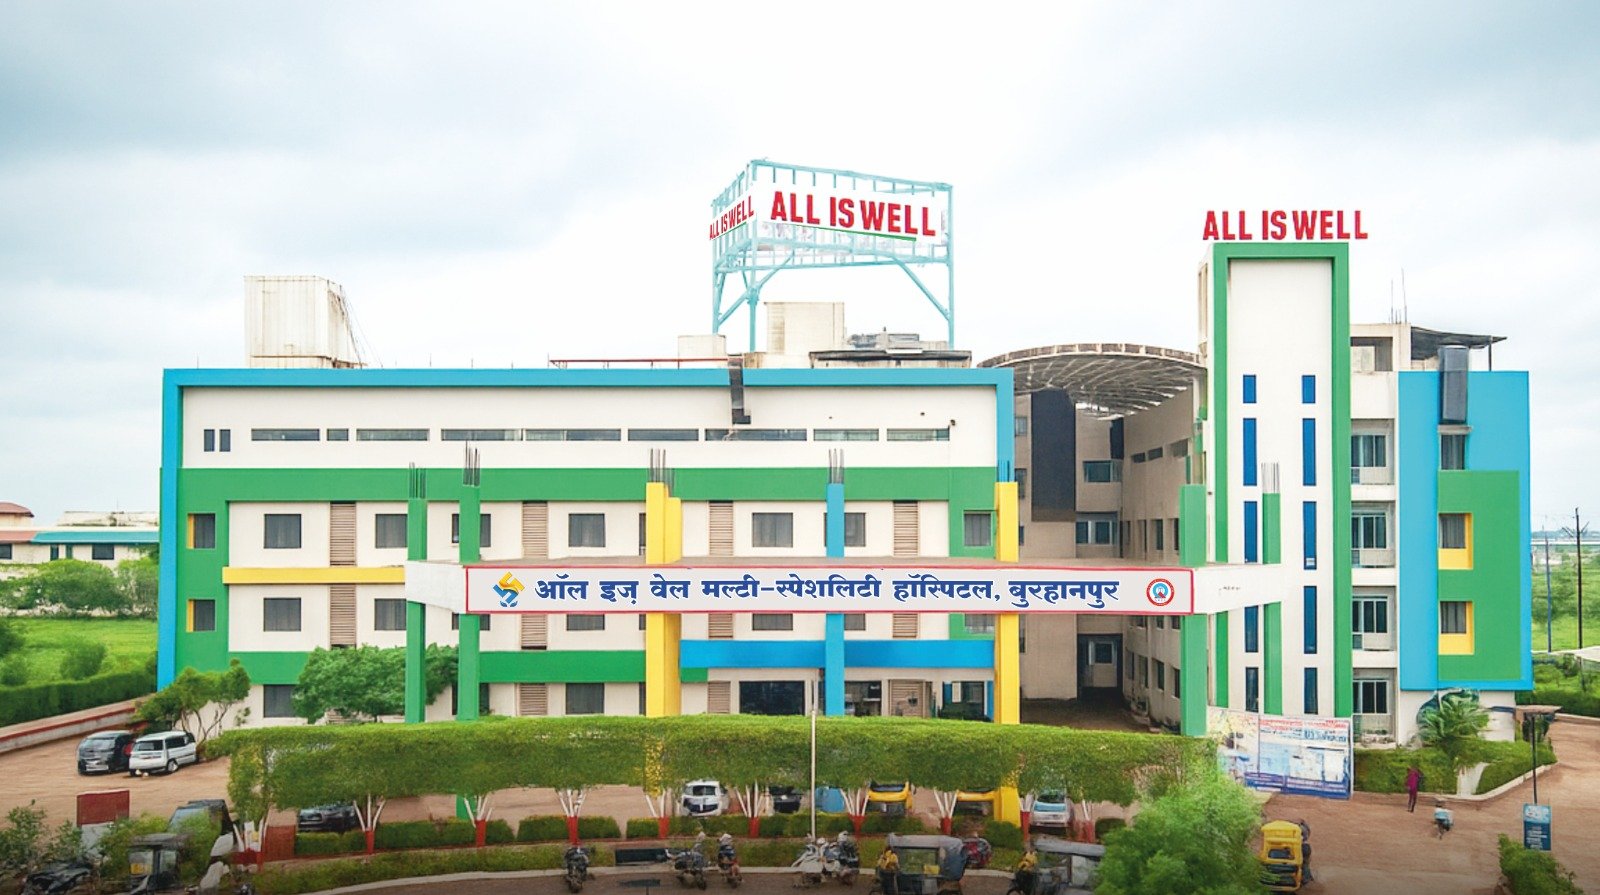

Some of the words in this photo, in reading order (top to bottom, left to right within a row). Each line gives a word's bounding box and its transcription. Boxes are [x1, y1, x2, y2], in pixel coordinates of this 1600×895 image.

[709, 220, 719, 240] ALL
[721, 213, 728, 234] IS
[729, 195, 754, 229] WELL
[770, 190, 821, 225] ALL
[829, 196, 855, 229] IS
[860, 199, 936, 237] WELL
[1202, 210, 1253, 241] ALL
[1261, 210, 1287, 241] IS
[1291, 210, 1369, 240] WELL
[535, 573, 589, 600] ऑल
[599, 580, 639, 605] इज़
[650, 573, 691, 599] वेल
[892, 573, 1000, 602] हॉस्पिटल,
[1008, 580, 1120, 609] बुरहानपुर
